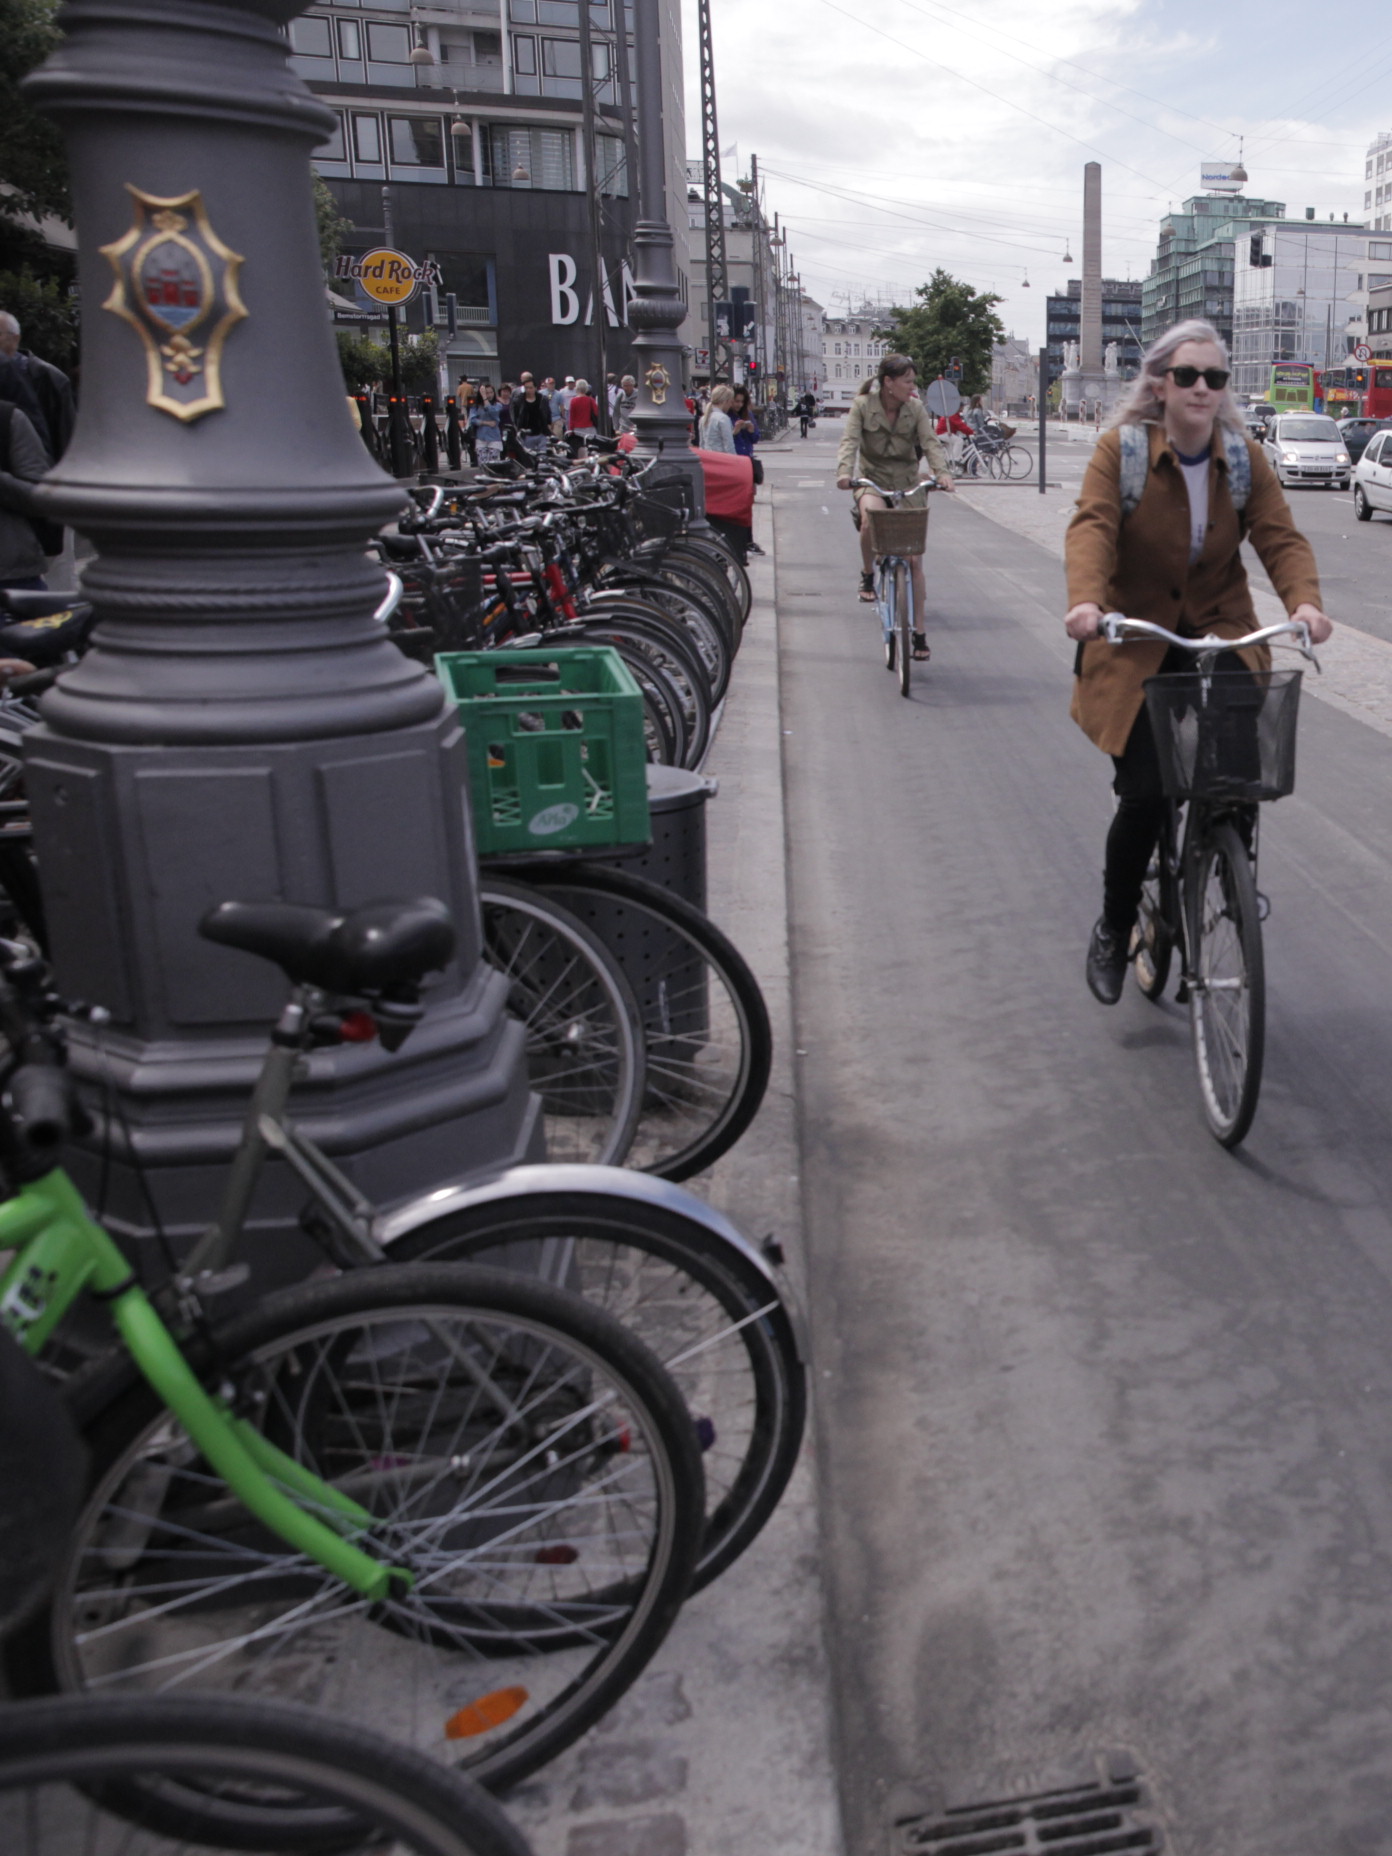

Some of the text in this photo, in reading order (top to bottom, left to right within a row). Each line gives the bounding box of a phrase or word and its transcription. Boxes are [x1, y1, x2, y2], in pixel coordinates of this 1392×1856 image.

[334, 255, 435, 286] Hard Rock
[375, 286, 401, 295] CAFE
